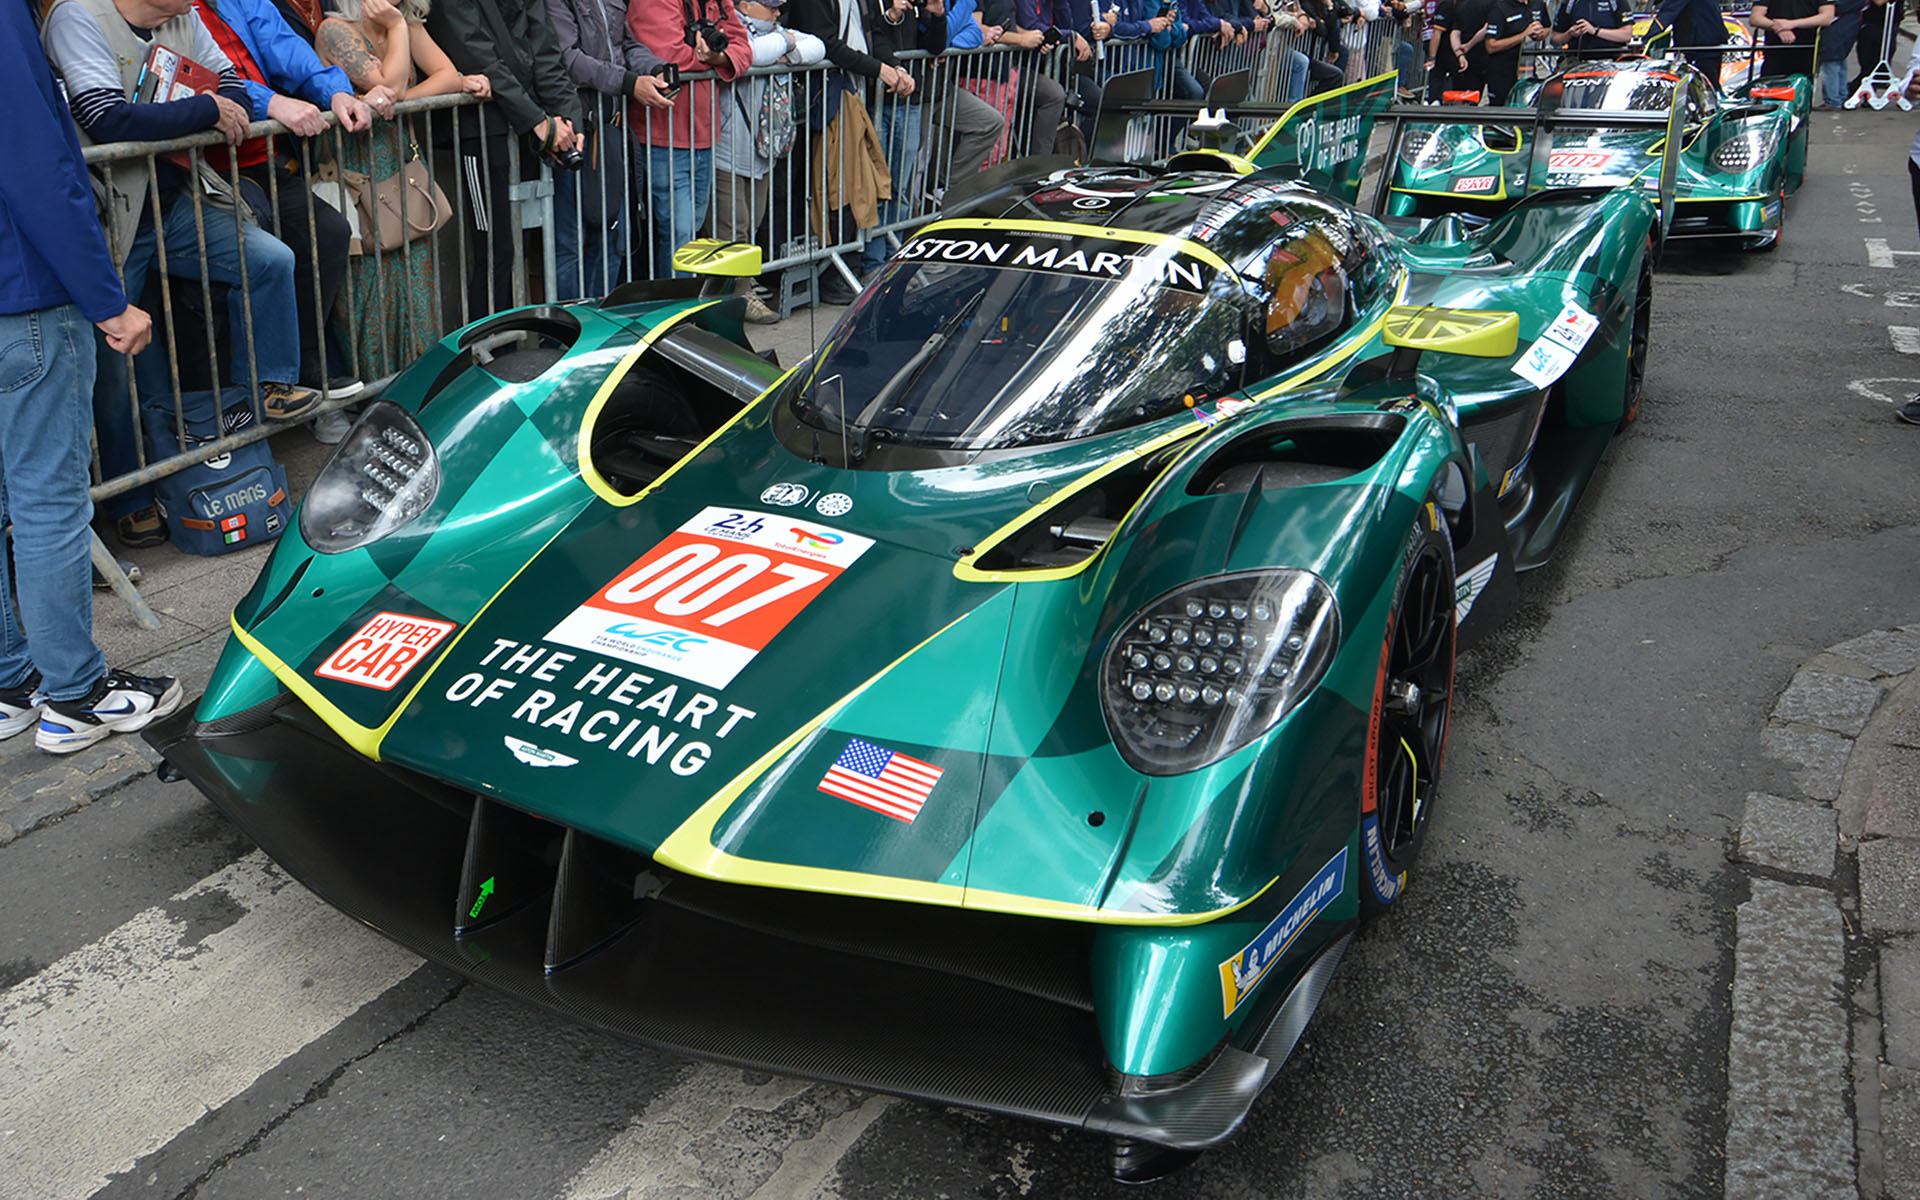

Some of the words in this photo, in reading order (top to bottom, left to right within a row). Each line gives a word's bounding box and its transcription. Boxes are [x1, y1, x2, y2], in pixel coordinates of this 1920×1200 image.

[1124, 114, 1151, 163] 007
[1318, 121, 1335, 145] THE
[1335, 114, 1361, 139] HEART
[1316, 145, 1329, 170] OF
[1329, 138, 1359, 166] RACING
[1457, 182, 1490, 190] CAR
[890, 239, 1011, 263] ASTON
[203, 500, 224, 519] LE
[604, 543, 830, 628] 007
[361, 617, 442, 648] HYPER
[590, 639, 648, 657] CHAMPIONSHIP
[603, 622, 709, 652] WEC
[331, 638, 418, 682] CAR
[479, 638, 577, 682] THE
[573, 662, 757, 739] HEART
[445, 672, 517, 708] OF
[511, 689, 713, 777] RACING
[1366, 825, 1397, 900] MICHELIN
[1262, 871, 1336, 964] MICHELIN
